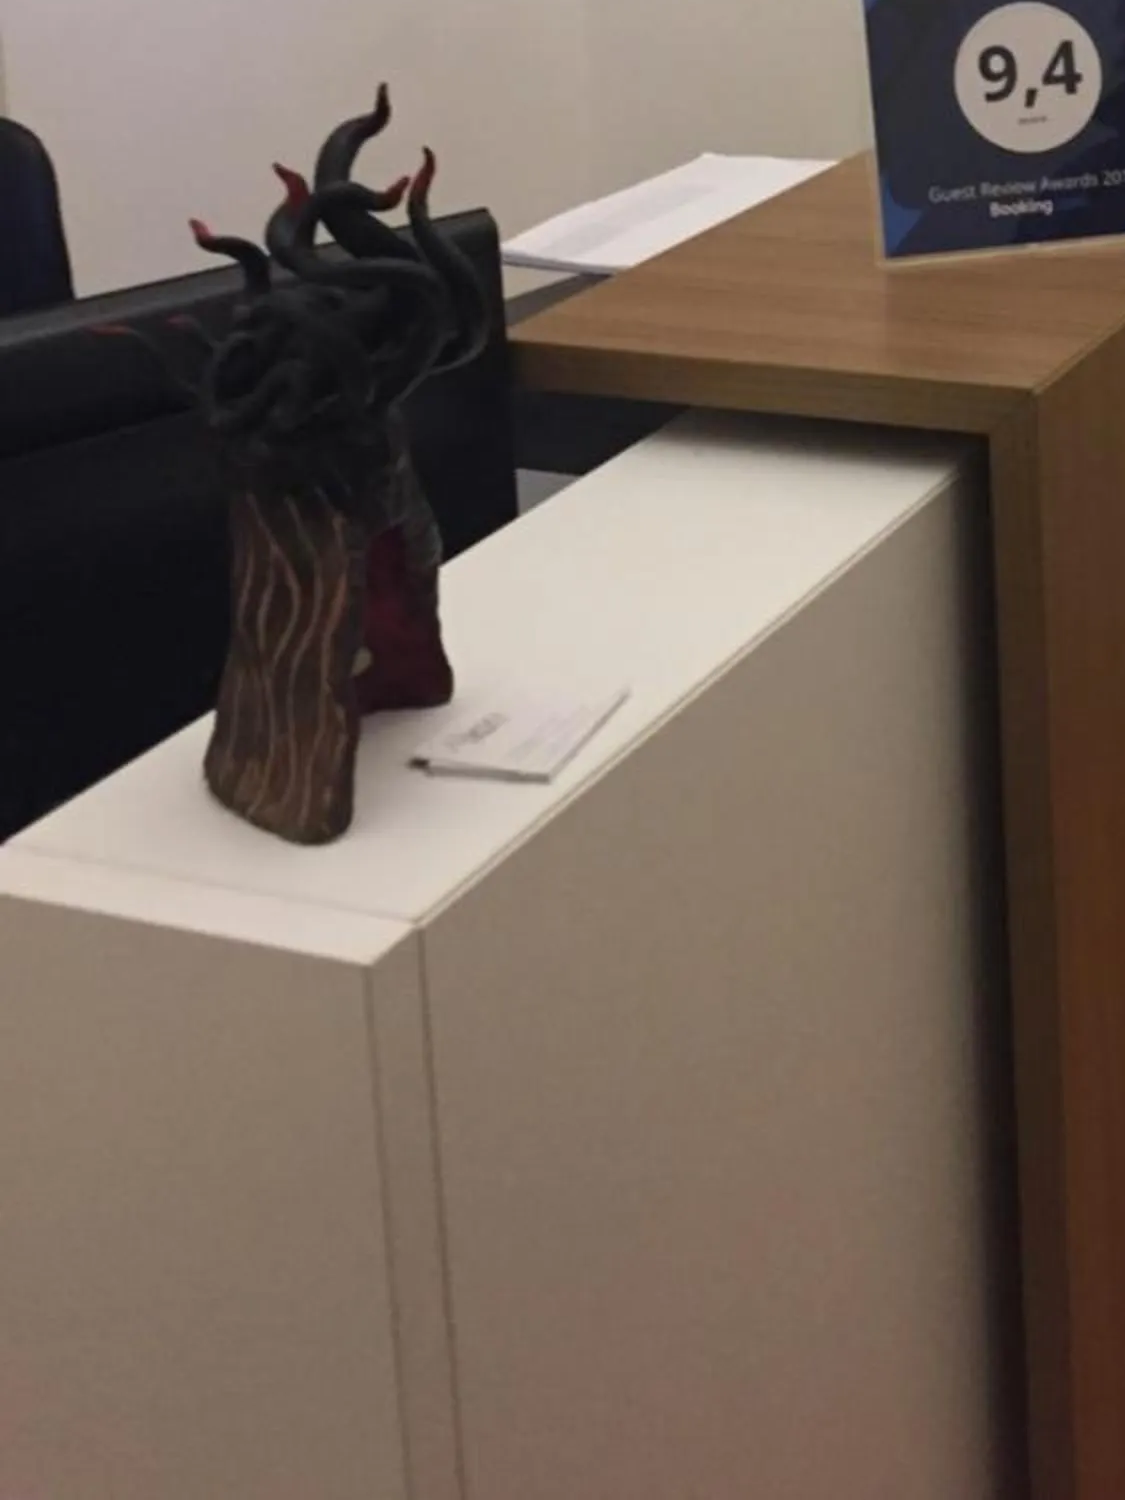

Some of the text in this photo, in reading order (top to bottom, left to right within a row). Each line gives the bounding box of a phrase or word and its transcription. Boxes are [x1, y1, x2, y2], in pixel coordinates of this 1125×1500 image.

[977, 39, 1083, 109] 9,4
[928, 184, 976, 203] Guest
[980, 179, 1036, 199] Review
[1040, 173, 1099, 192] Awards
